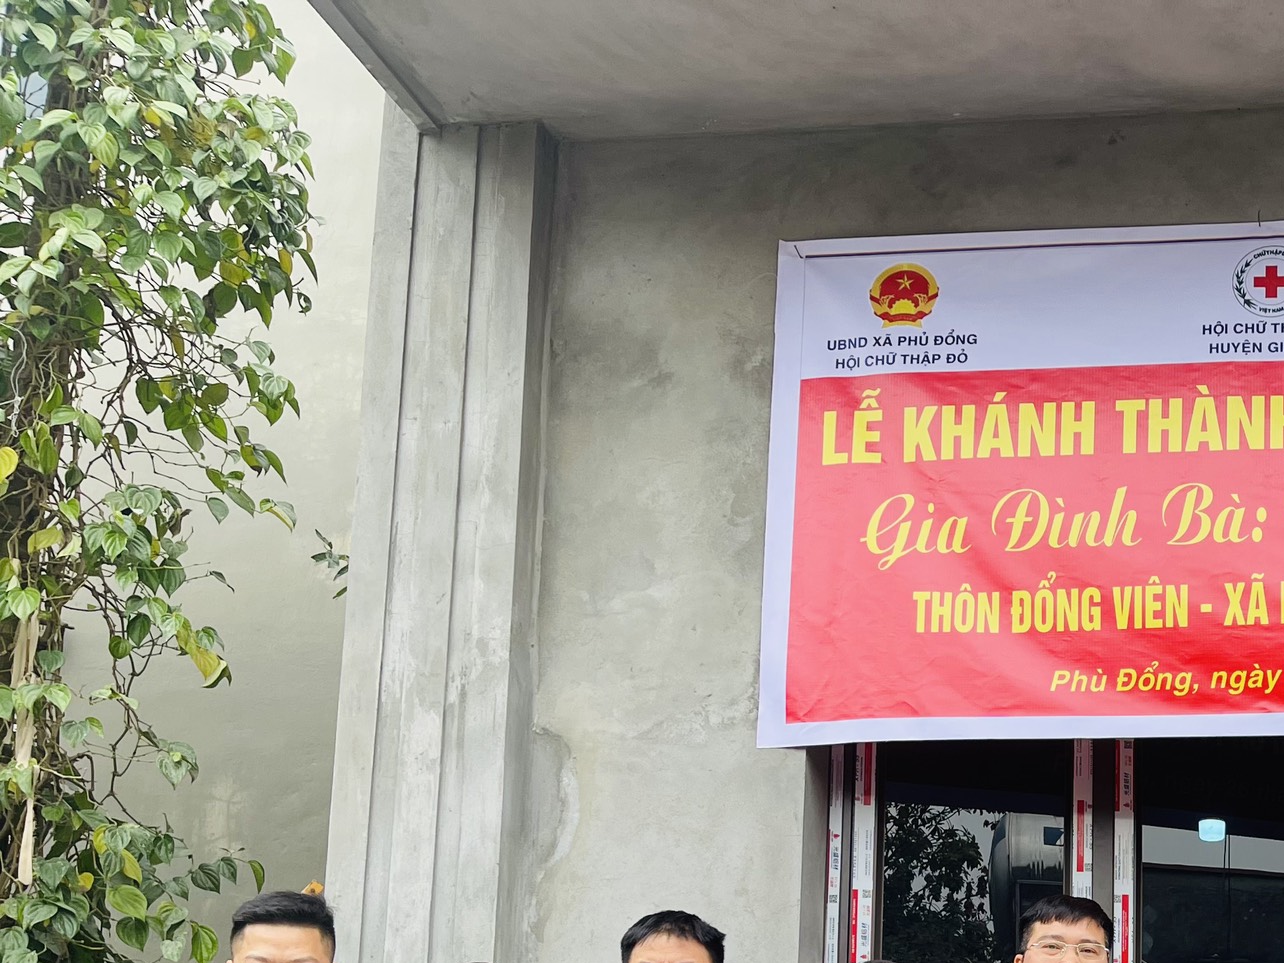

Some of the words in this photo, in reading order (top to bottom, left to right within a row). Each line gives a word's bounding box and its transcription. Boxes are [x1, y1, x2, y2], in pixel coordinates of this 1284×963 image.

[827, 336, 868, 351] UBND
[872, 333, 893, 347] XÃ
[933, 328, 978, 346] ĐỔNG
[1202, 320, 1229, 337] HỘI
[1232, 320, 1268, 335] CHỮ
[835, 354, 860, 371] HỘI
[864, 351, 897, 367] CHỮ
[900, 350, 942, 367] THẬP
[945, 348, 968, 364] ĐỎ
[1209, 339, 1263, 356] HUYỆN
[823, 389, 884, 466] LỄ
[904, 391, 1096, 464] KHÁNH
[860, 493, 971, 568] Gia
[991, 486, 1140, 553] Đình
[1161, 483, 1270, 547] Bà:
[913, 584, 1001, 634] THÔN
[1011, 572, 1102, 634] ĐỔNG
[1113, 576, 1189, 631] VIÊN
[1200, 604, 1214, 614] -
[1224, 574, 1270, 627] XÃ
[1050, 667, 1107, 693] Phù
[1116, 661, 1199, 697] Đổng,
[1210, 664, 1282, 695] ngày
